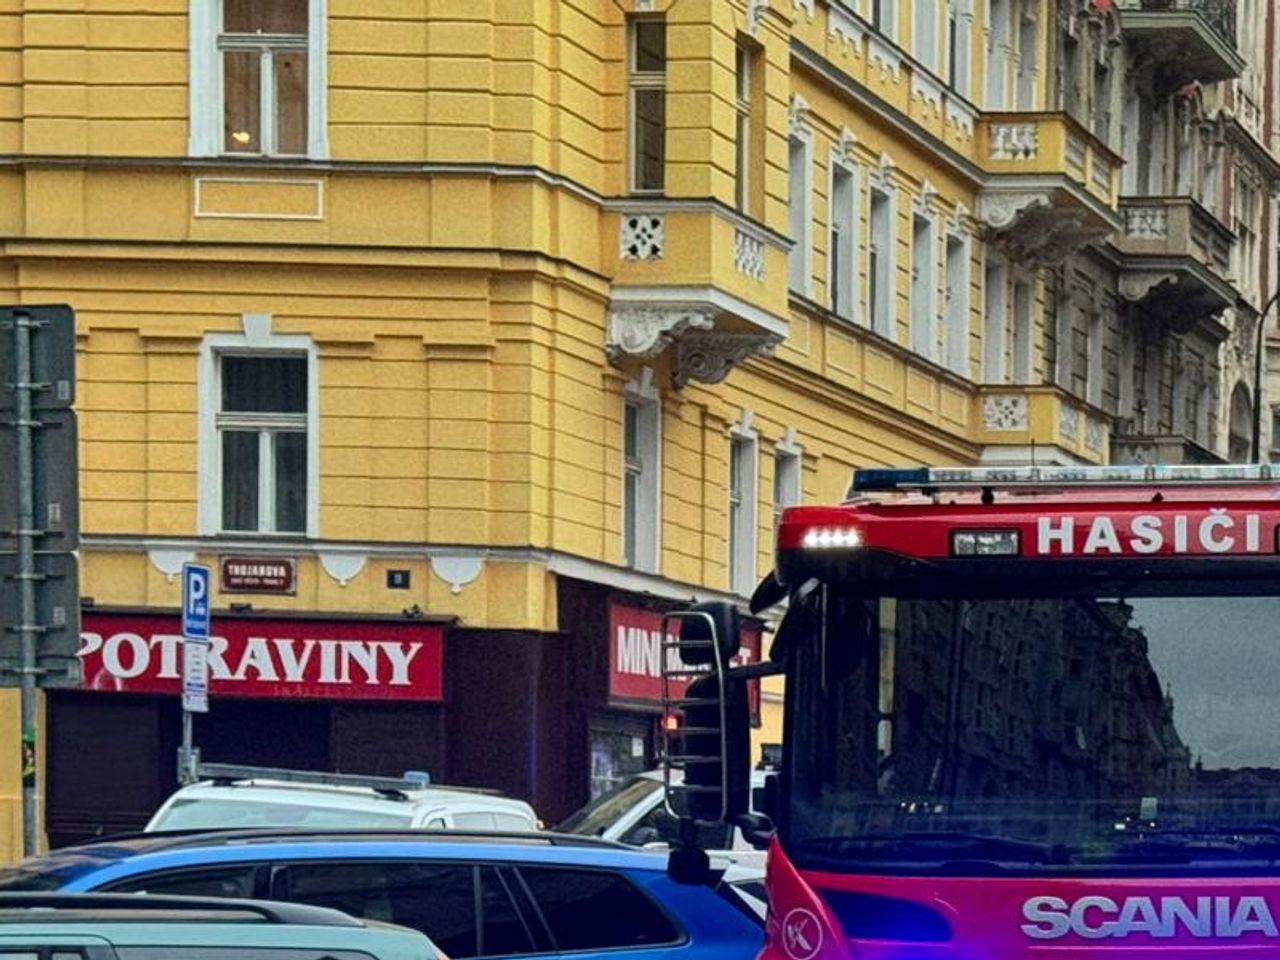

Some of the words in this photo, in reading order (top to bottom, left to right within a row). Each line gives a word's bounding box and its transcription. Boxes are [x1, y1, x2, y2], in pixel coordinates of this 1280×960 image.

[1037, 507, 1260, 554] HASIČI
[188, 572, 205, 615] P
[1020, 895, 1280, 939] SCANIA
